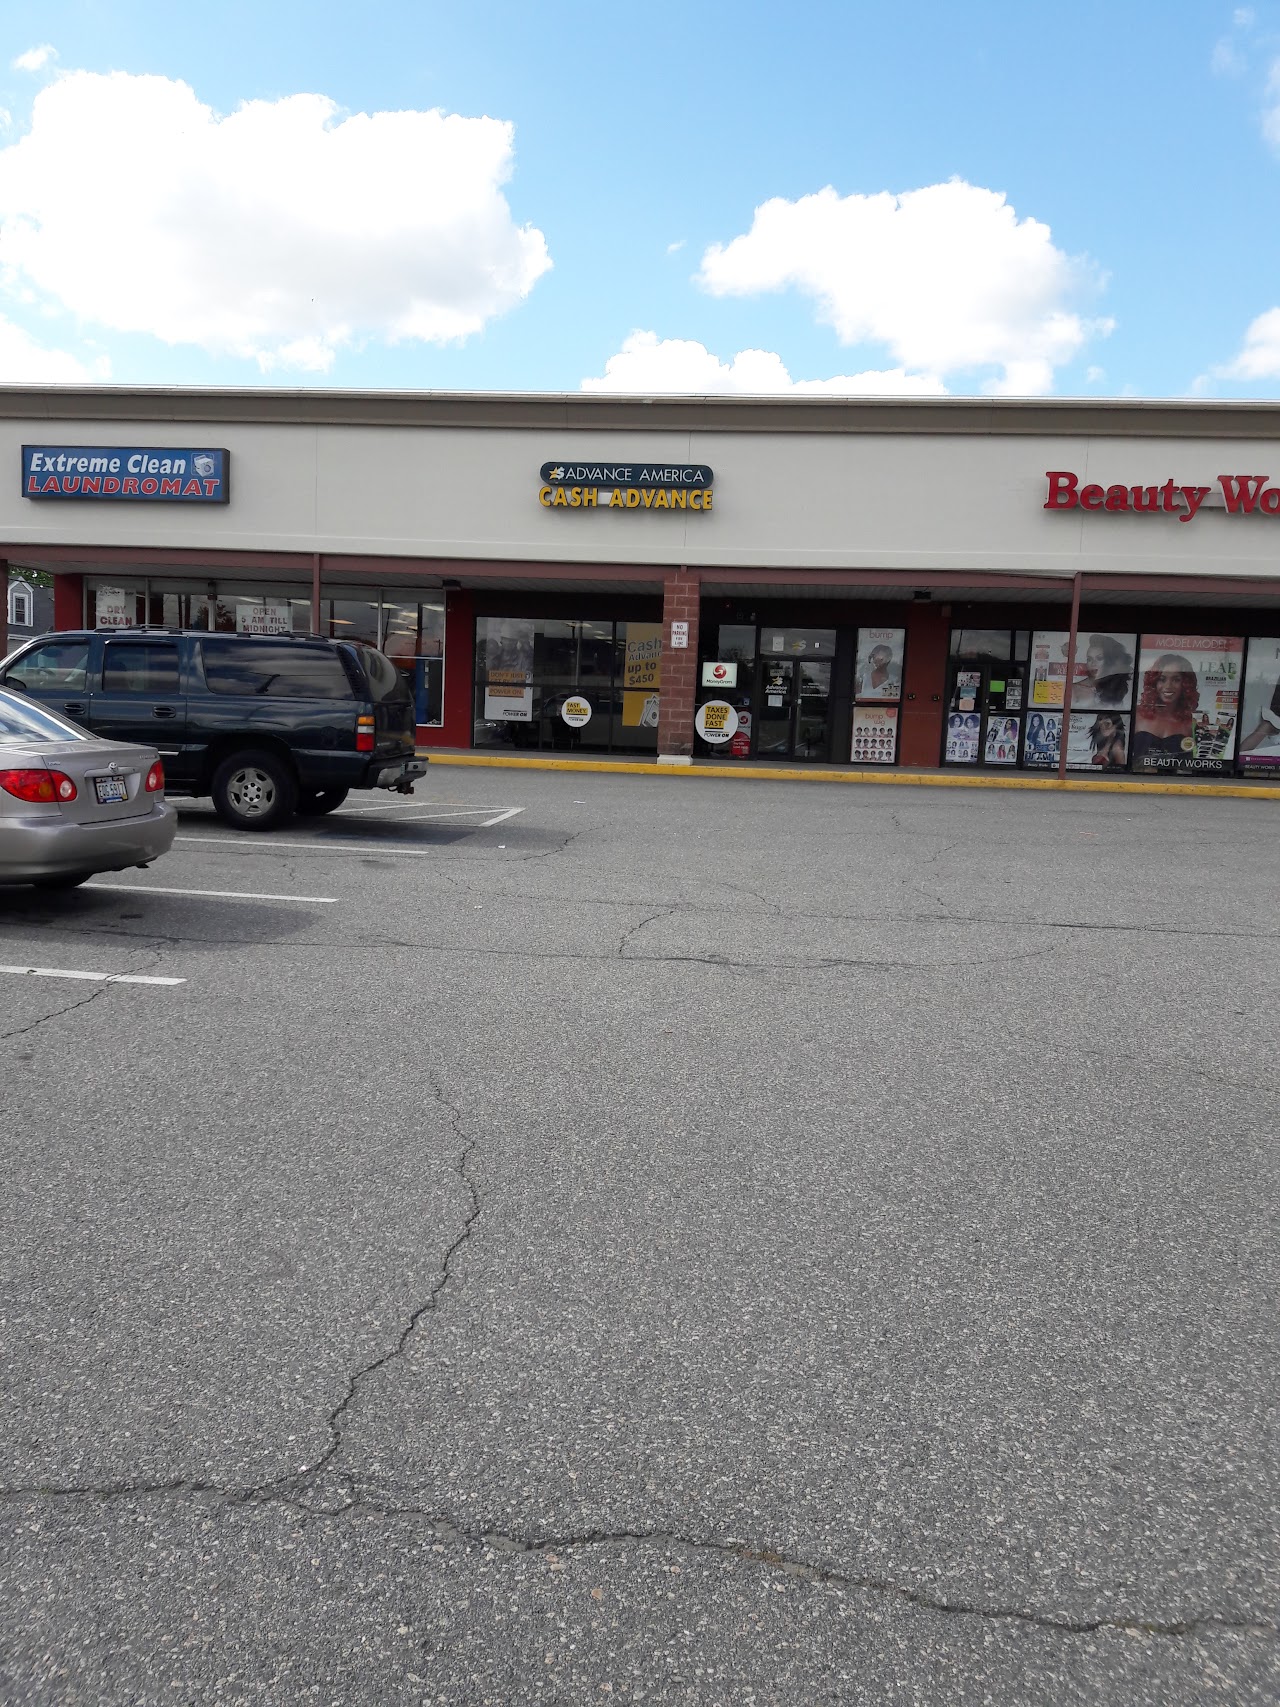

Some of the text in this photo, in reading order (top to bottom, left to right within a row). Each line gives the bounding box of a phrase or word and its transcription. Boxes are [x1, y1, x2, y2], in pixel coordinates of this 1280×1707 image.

[30, 453, 187, 474] Extreme Clean
[565, 467, 704, 482] ADVANCE AMERICA
[27, 475, 220, 496] LAUNDROMAT
[538, 486, 713, 510] CASH ADVANCE
[1043, 471, 1211, 523] Beauty
[107, 605, 127, 614] DRY
[253, 607, 277, 615] OPEN
[100, 616, 133, 626] CLEAN
[251, 616, 265, 624] AM
[243, 625, 286, 633] MIDNIGHT
[869, 630, 893, 639] bump
[627, 637, 662, 653] Cash
[1155, 637, 1228, 649] MODEL MODEL
[628, 662, 657, 674] up to
[1199, 662, 1237, 674] LEAF
[629, 673, 654, 685] $450
[865, 713, 883, 721] bump
[1143, 757, 1223, 769] BEAUTY WORKS
